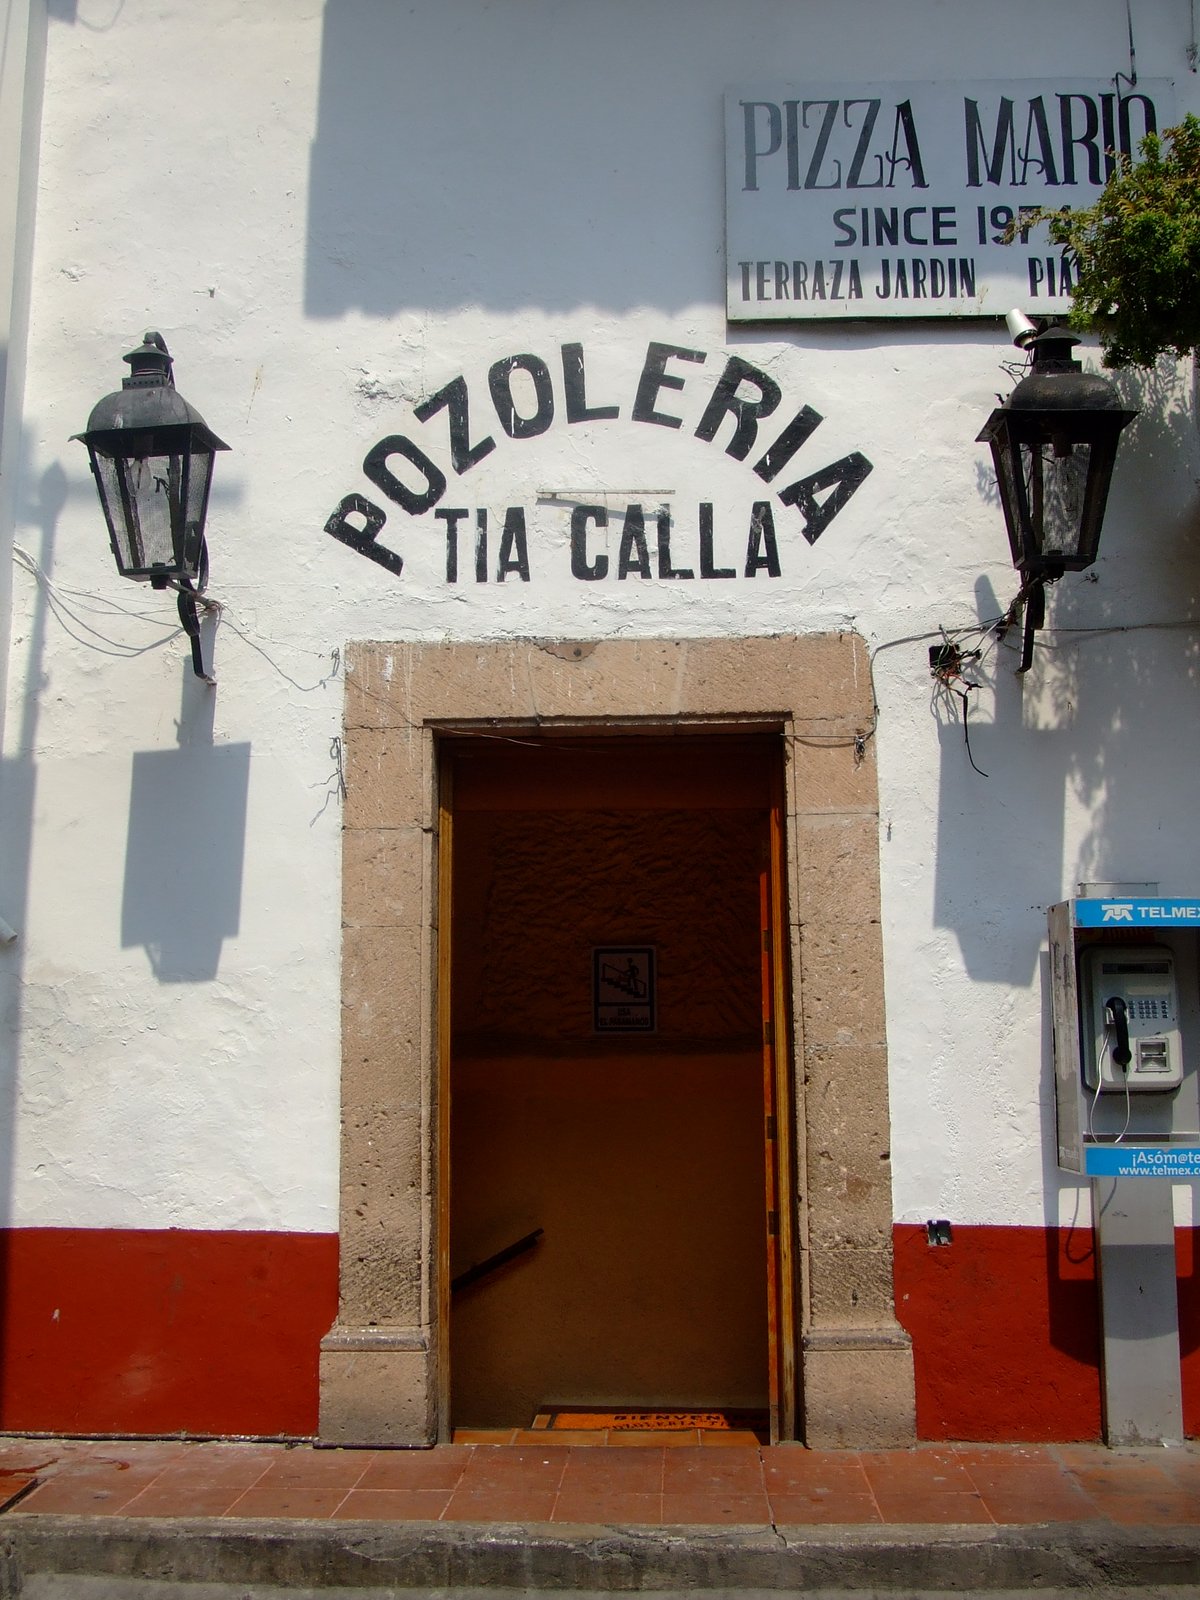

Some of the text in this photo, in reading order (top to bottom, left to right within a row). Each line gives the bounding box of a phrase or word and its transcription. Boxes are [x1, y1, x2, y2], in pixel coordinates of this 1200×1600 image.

[738, 98, 929, 192] PIZZA
[832, 205, 958, 248] SINCE
[737, 258, 863, 302] TERRAZA
[875, 257, 976, 300] JARDIN
[323, 341, 874, 577] POZOLERIA
[434, 500, 783, 583] TIA CALLA
[1118, 1165, 1200, 1176] www.telmex.c
